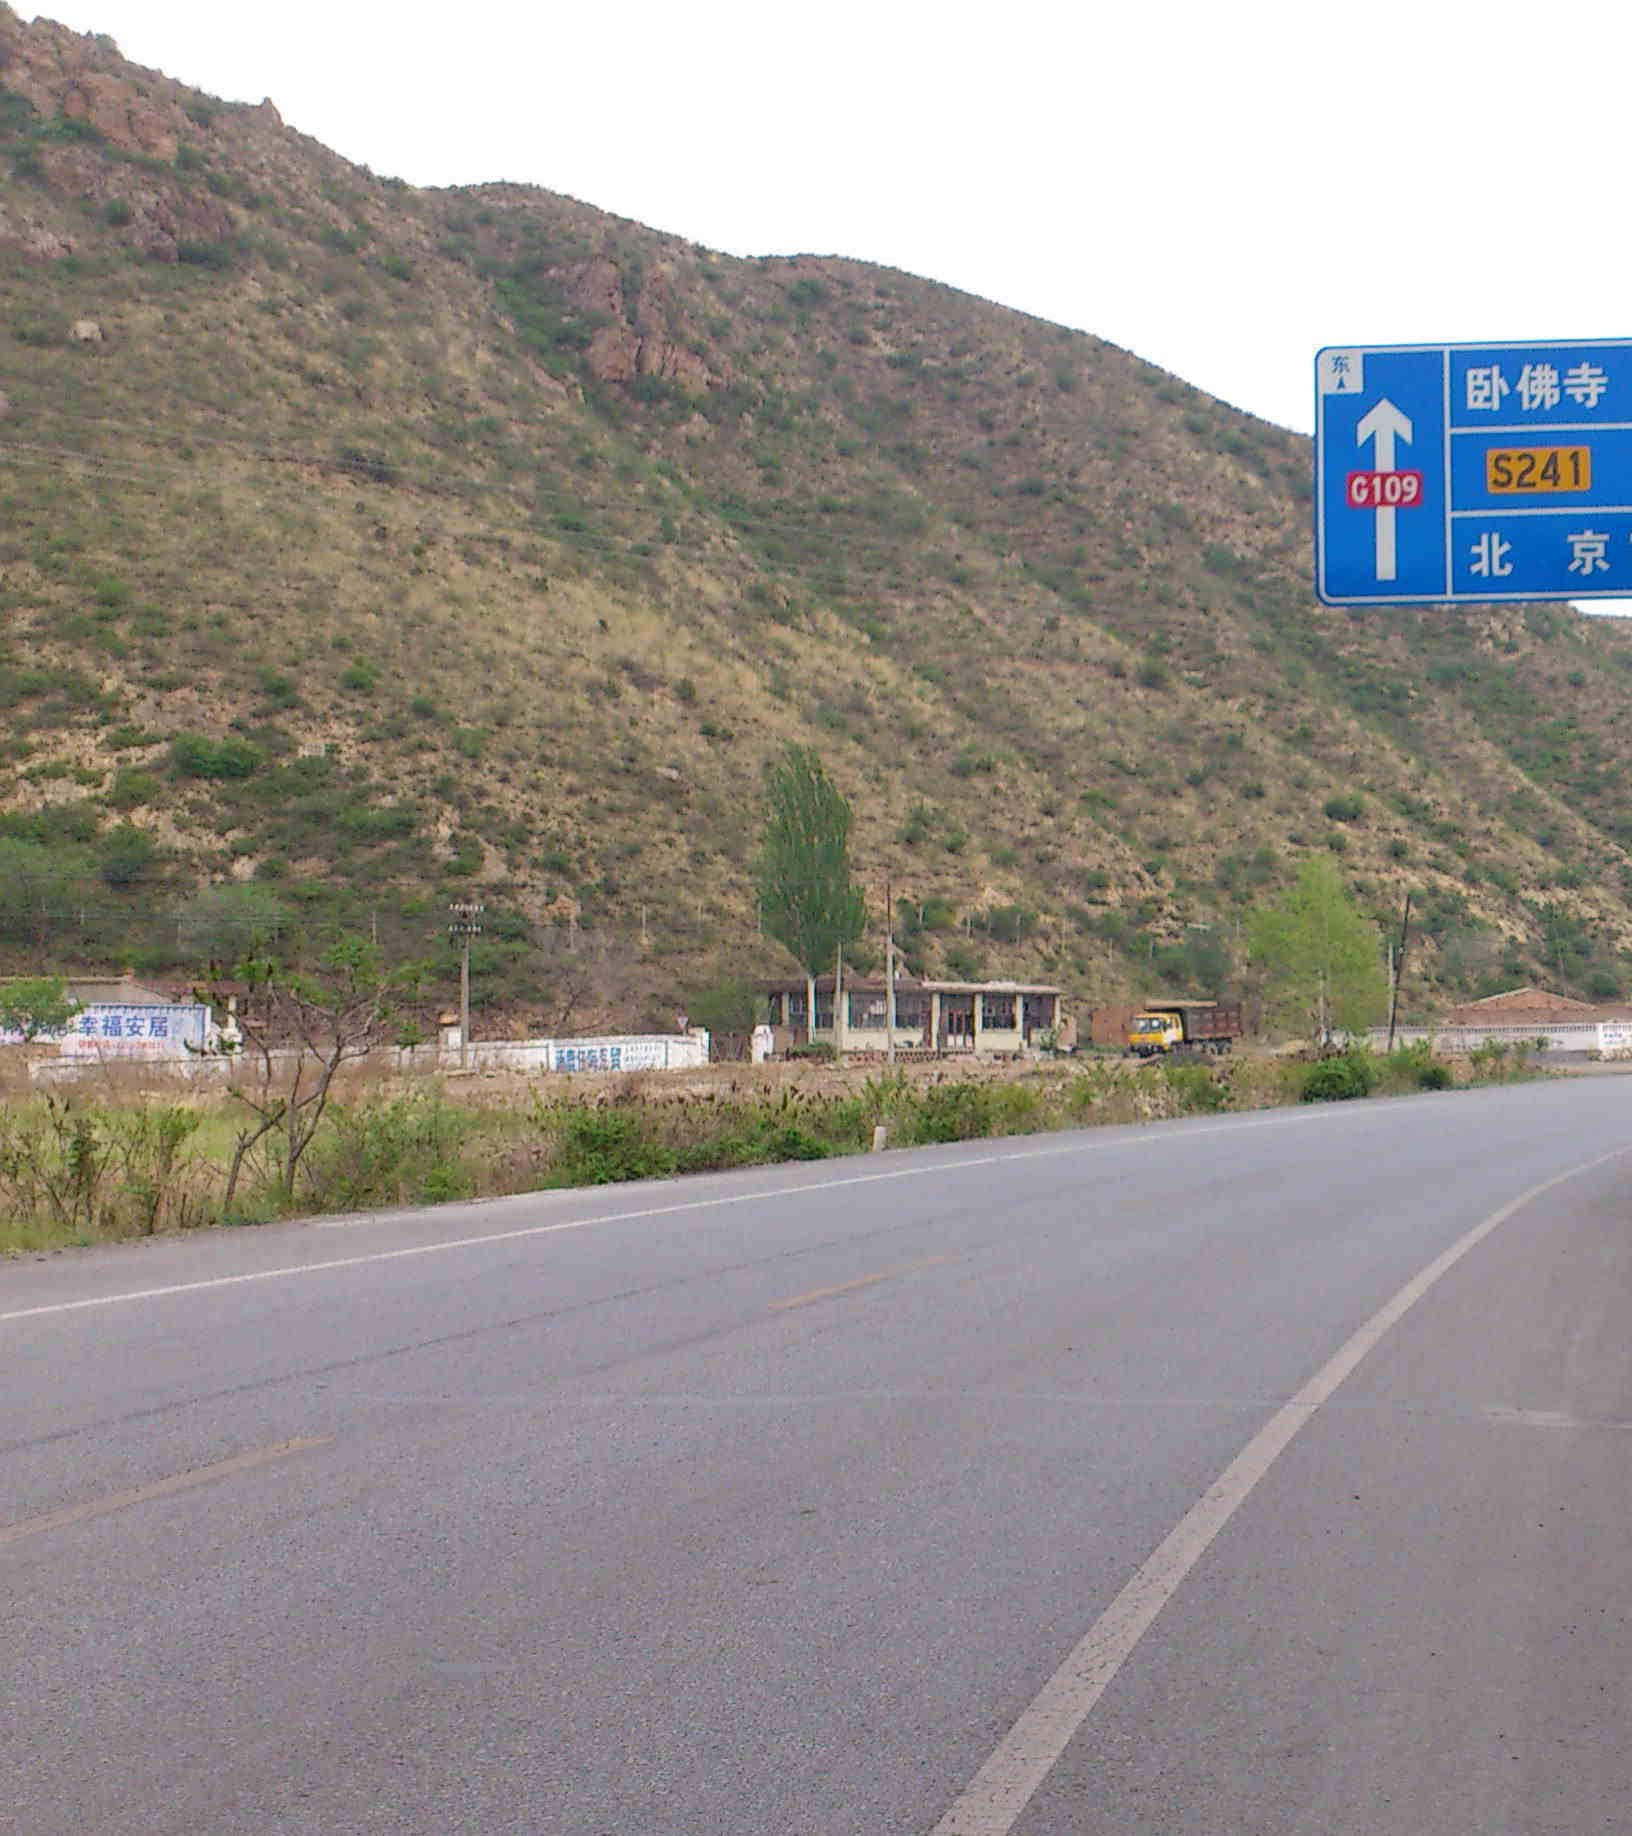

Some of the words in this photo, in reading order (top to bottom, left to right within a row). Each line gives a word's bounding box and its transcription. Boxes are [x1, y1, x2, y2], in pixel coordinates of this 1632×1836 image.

[1331, 355, 1351, 374] 东
[1466, 361, 1609, 411] 卧佛寺
[1492, 450, 1585, 489] S241
[1350, 474, 1418, 505] G109
[1470, 530, 1611, 577] 北京
[79, 1015, 169, 1037] 幸福安居
